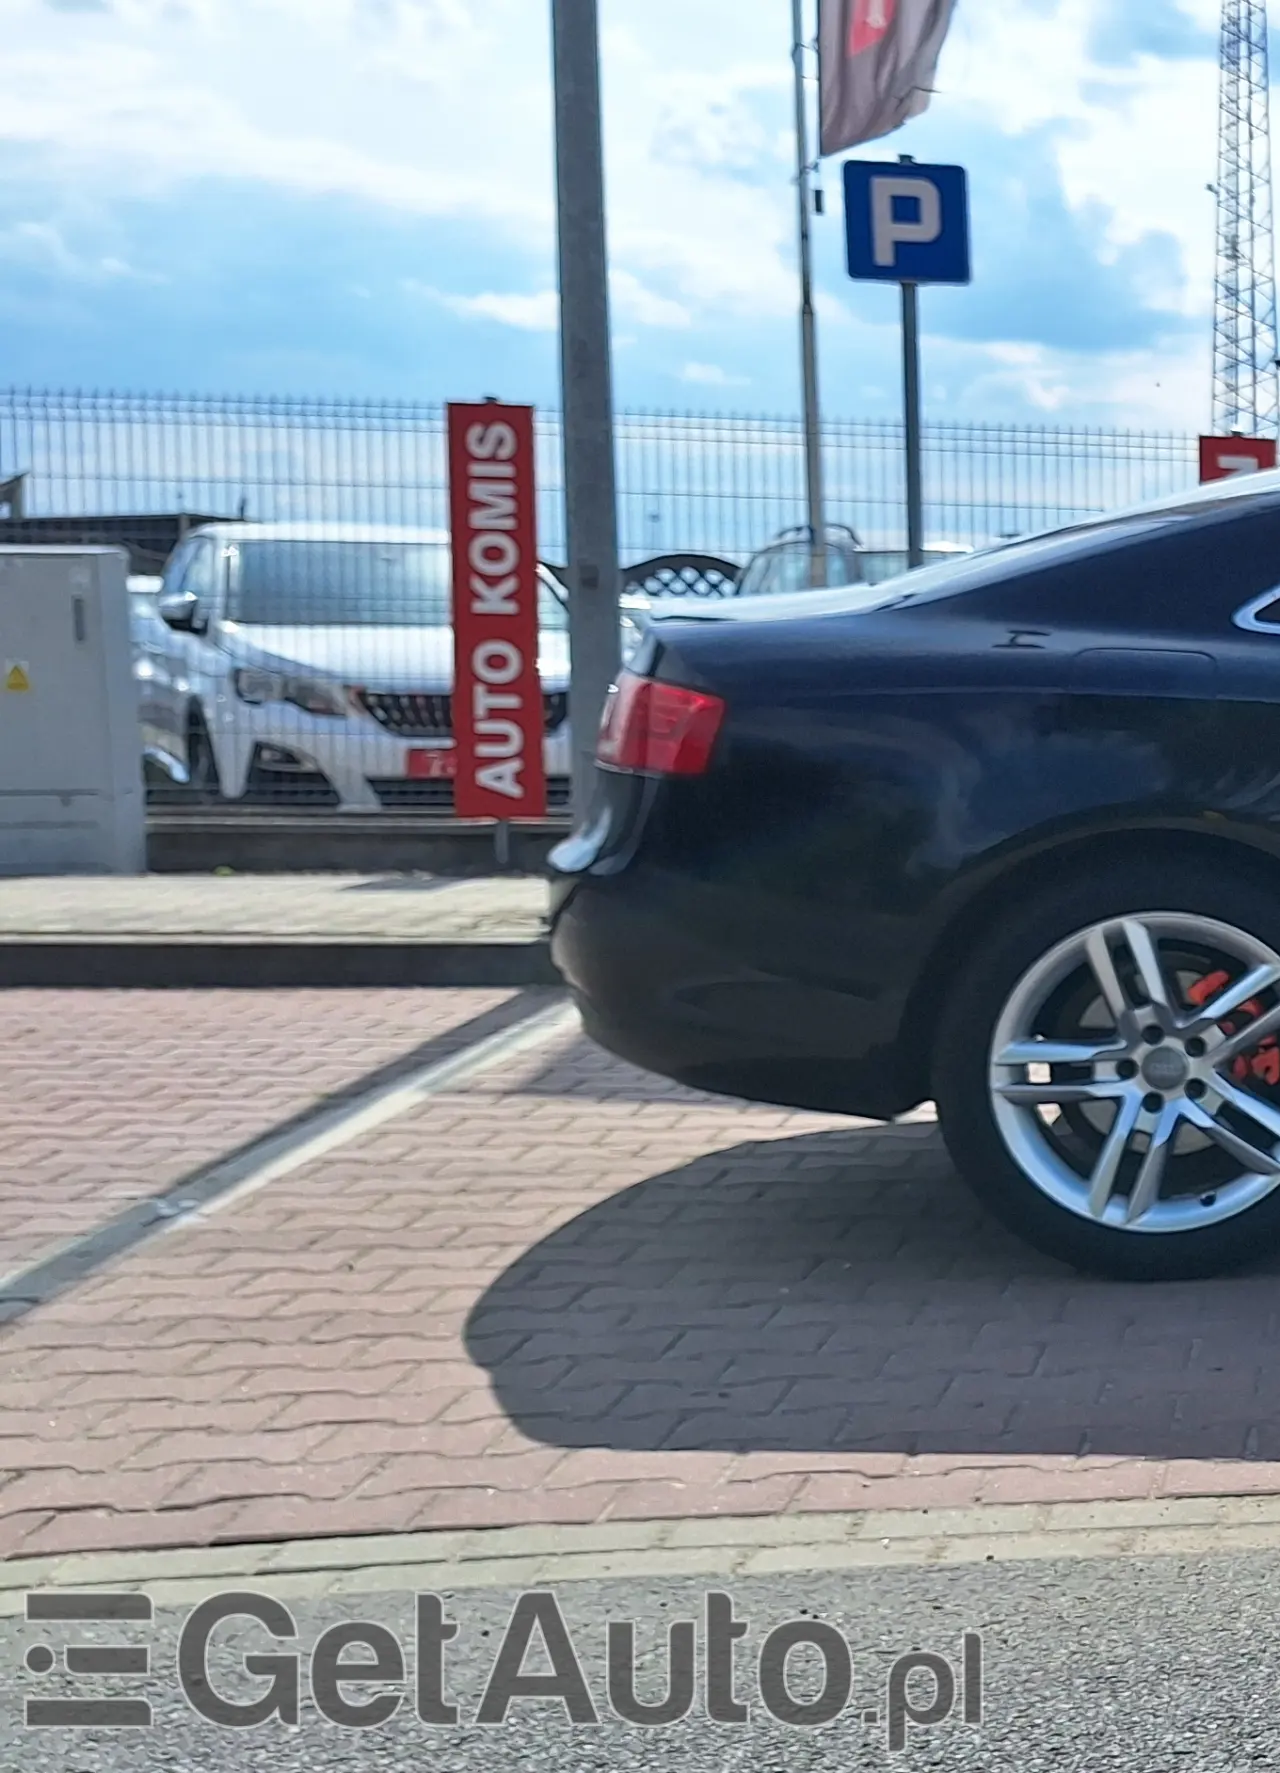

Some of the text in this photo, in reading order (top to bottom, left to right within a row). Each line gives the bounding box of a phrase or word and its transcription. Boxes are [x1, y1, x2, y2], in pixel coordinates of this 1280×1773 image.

[871, 176, 941, 267] P
[466, 422, 524, 799] AUTO KOMIS
